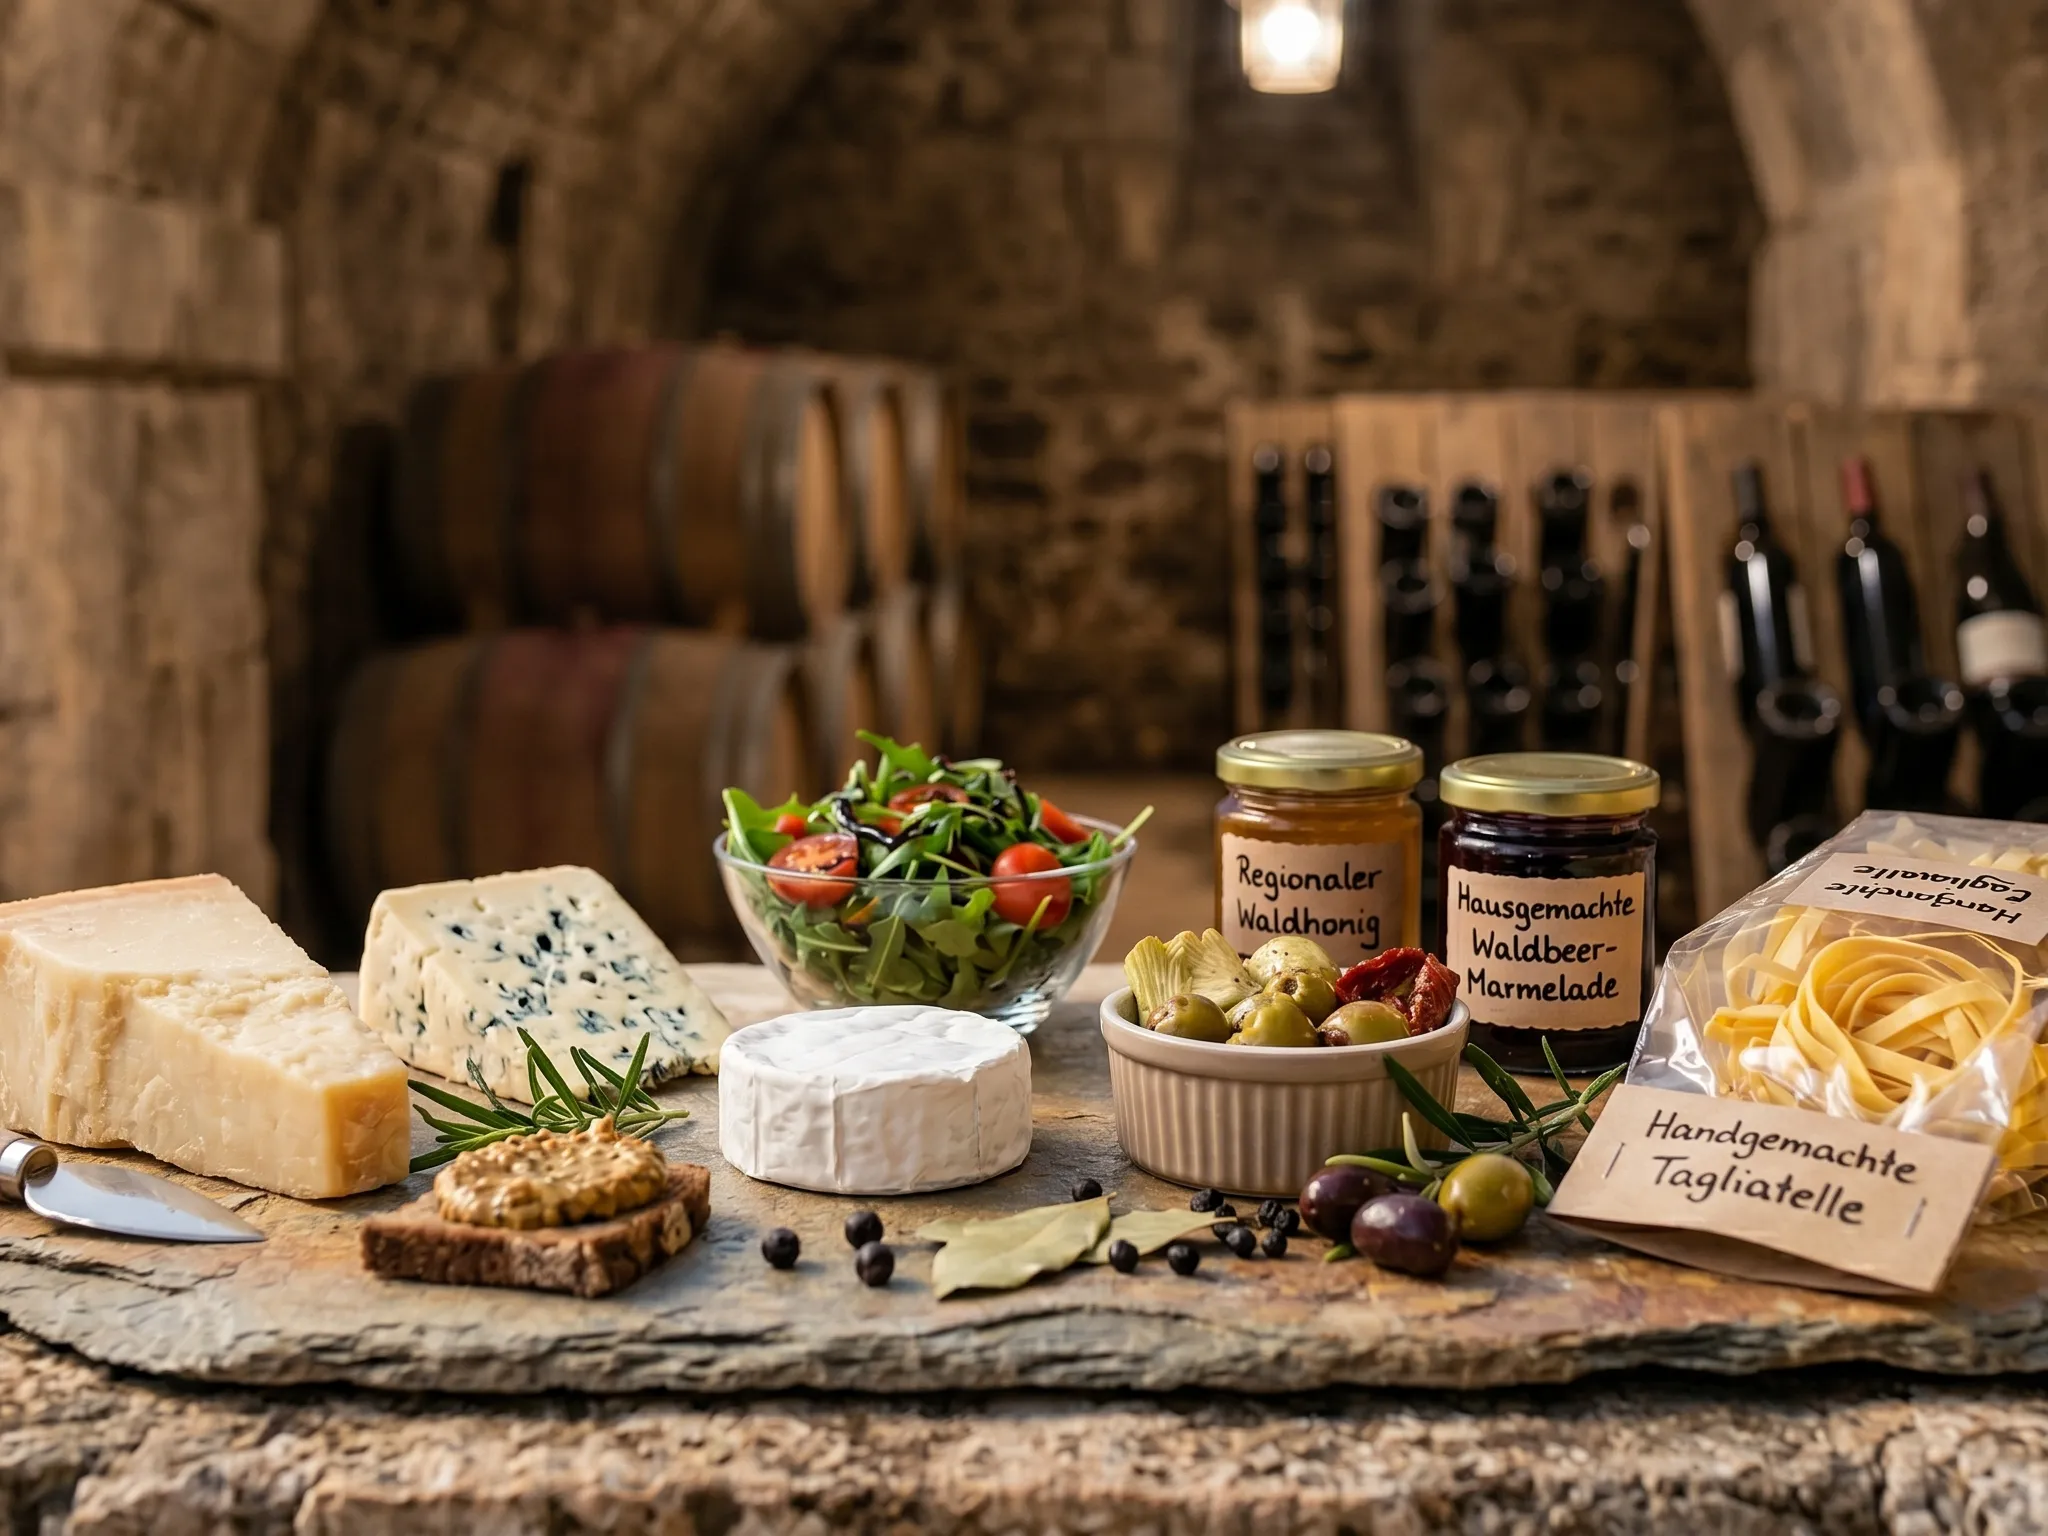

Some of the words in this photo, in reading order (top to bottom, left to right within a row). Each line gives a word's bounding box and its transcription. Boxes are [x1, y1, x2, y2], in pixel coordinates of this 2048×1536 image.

[1236, 854, 1382, 900] Regionaler
[1236, 898, 1381, 949] Waldhonig
[1457, 881, 1635, 930] Hausgemachte
[1473, 927, 1618, 963] Waldbeer-
[1467, 967, 1619, 1000] Marmelade
[1645, 1109, 1918, 1184] Handgemachte
[1650, 1156, 1865, 1225] Tagliatelle
